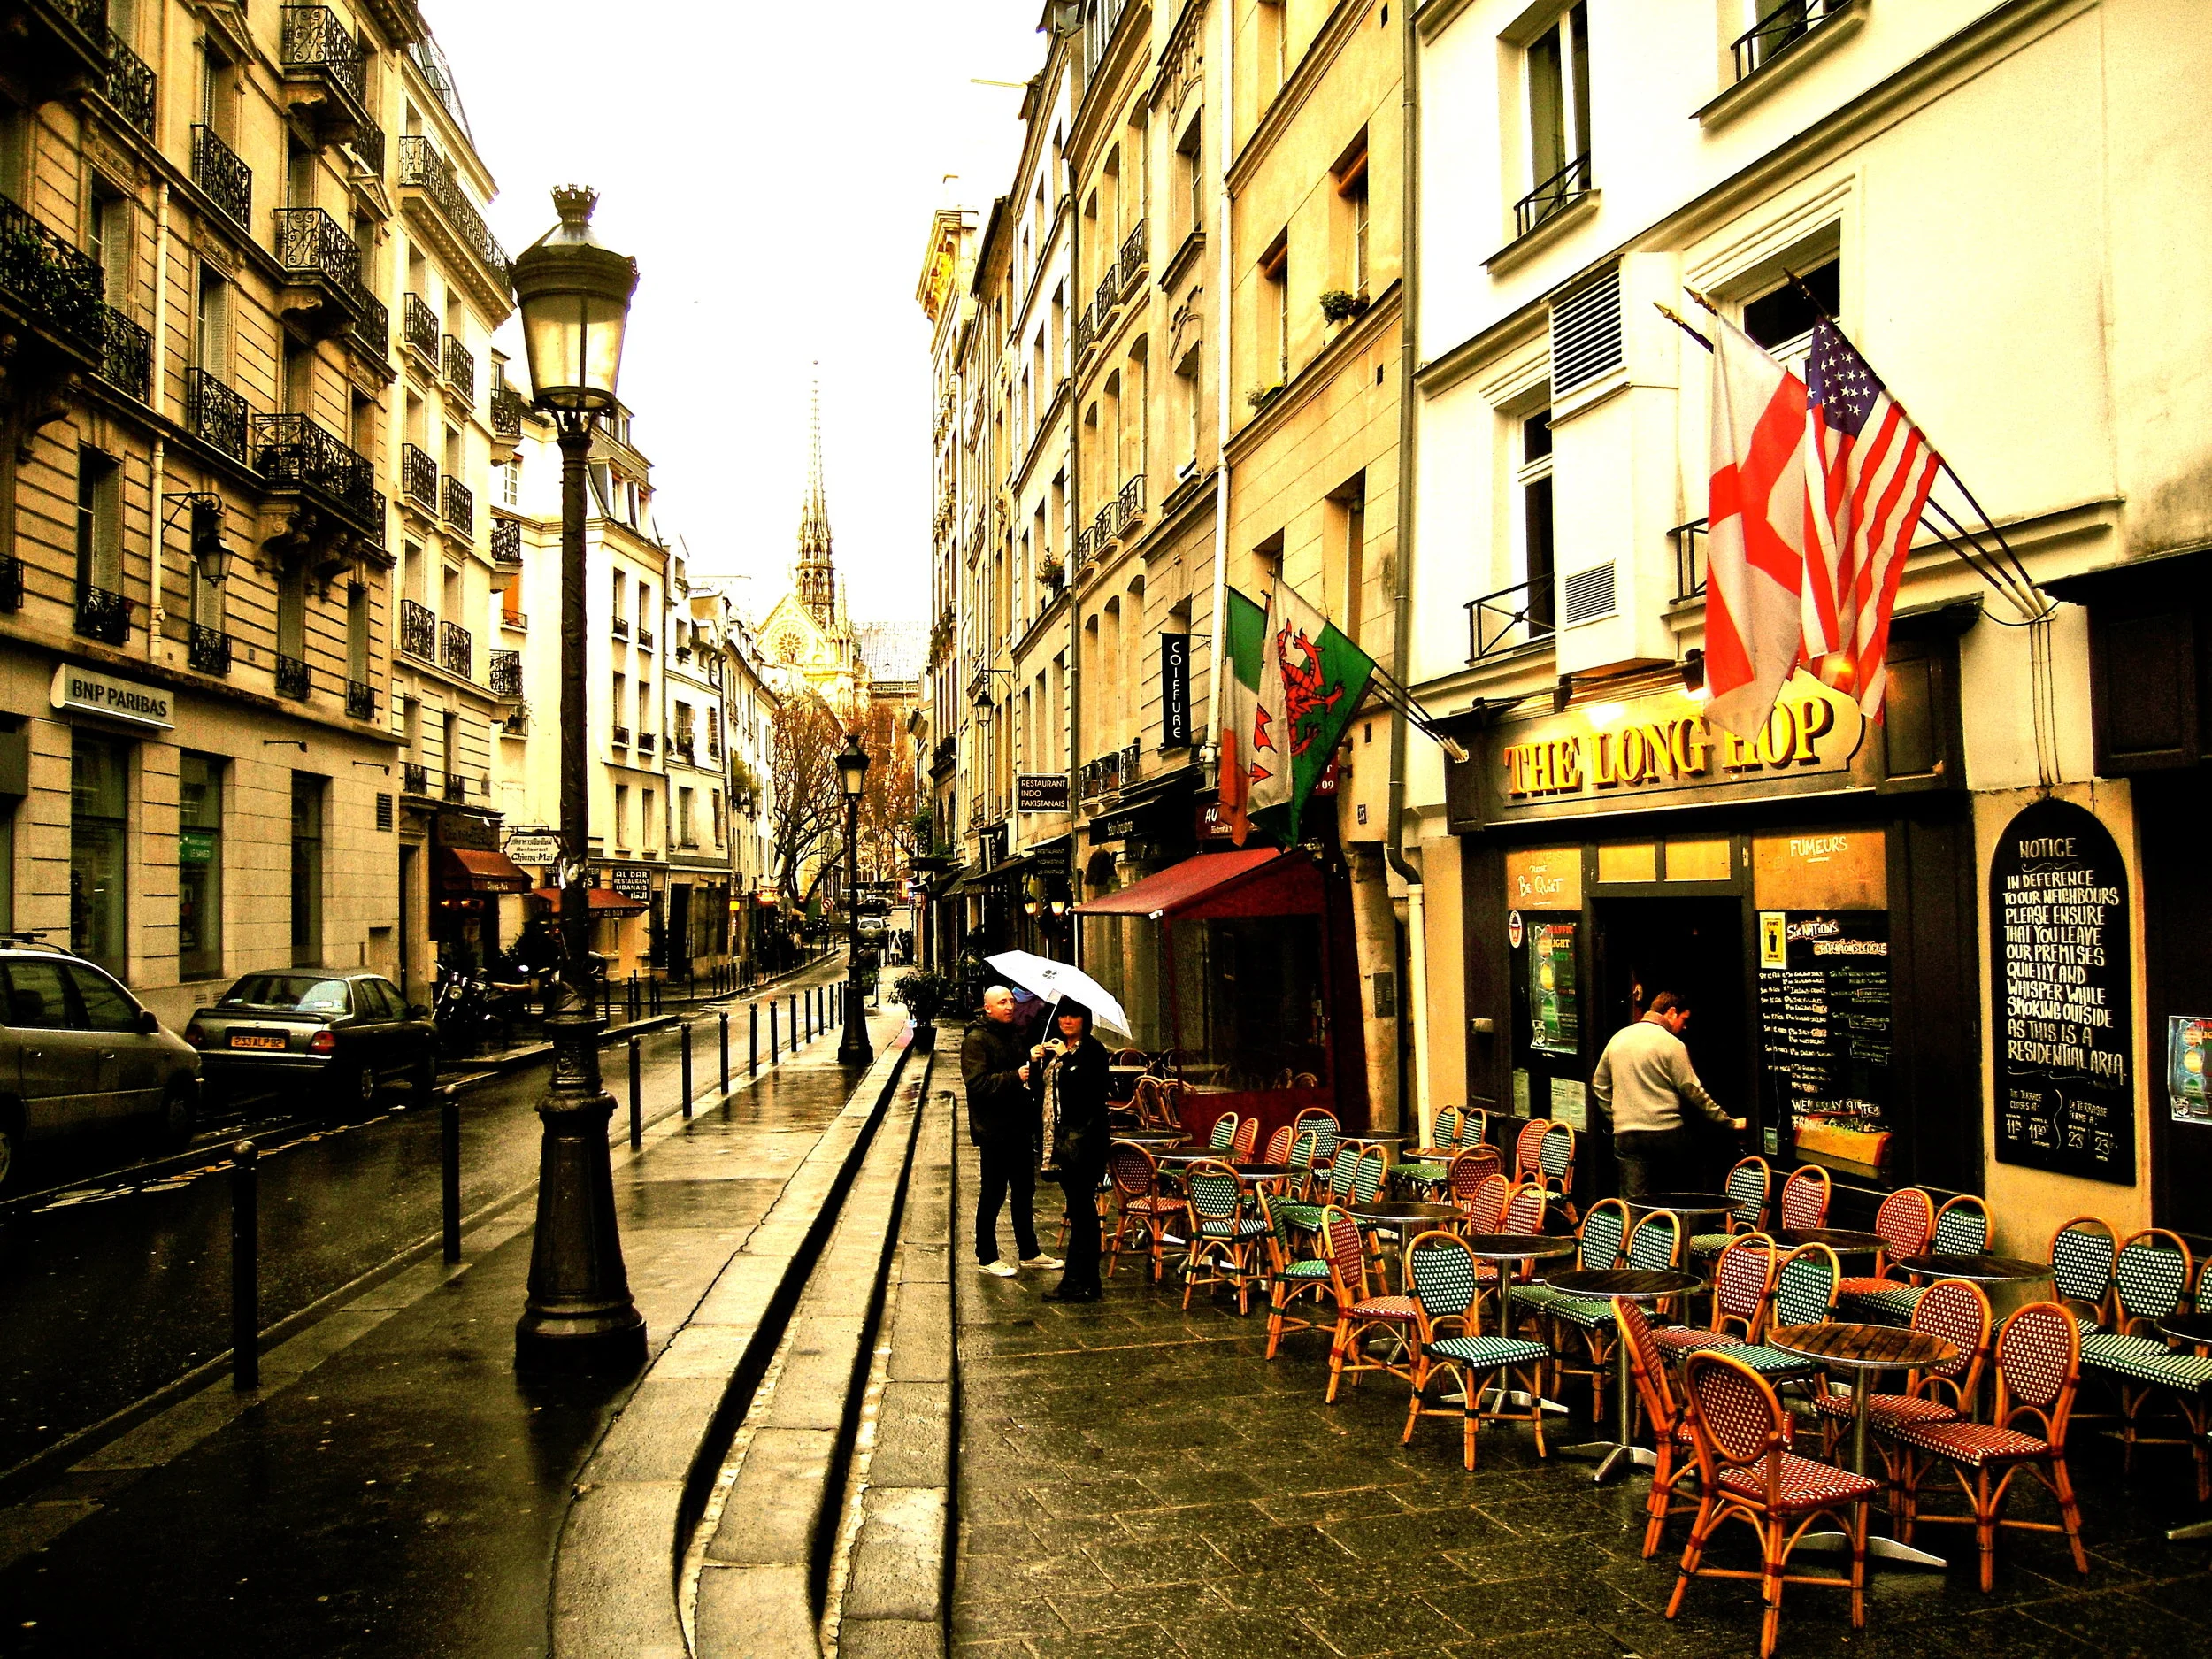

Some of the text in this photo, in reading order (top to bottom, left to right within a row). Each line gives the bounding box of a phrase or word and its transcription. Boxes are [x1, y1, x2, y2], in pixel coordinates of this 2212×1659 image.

[73, 679, 167, 717] BNP PARIBAS
[1169, 641, 1182, 738] COIFFURE
[1504, 735, 1583, 796] THE
[1590, 715, 1711, 787] LONG
[1204, 808, 1219, 824] AU
[1790, 836, 1848, 857] FUMEURS
[2019, 838, 2078, 858] NOTICE
[2007, 870, 2094, 890] IN DEFERENCE
[2002, 887, 2120, 906] TO OUR NEIGHBOURS
[2005, 905, 2106, 926] PLEASE ENSURE
[2004, 925, 2102, 946] THAT YOU LEAVE
[2006, 944, 2105, 967] OUR PREMISES
[2058, 965, 2086, 985] AND
[2006, 979, 2106, 1006] WHISPER WHILE
[2007, 996, 2114, 1029] SMOKING OUTSIDE
[2008, 1018, 2093, 1048] AS THIS IS A
[2008, 1040, 2088, 1071] RESIDENTIAL
